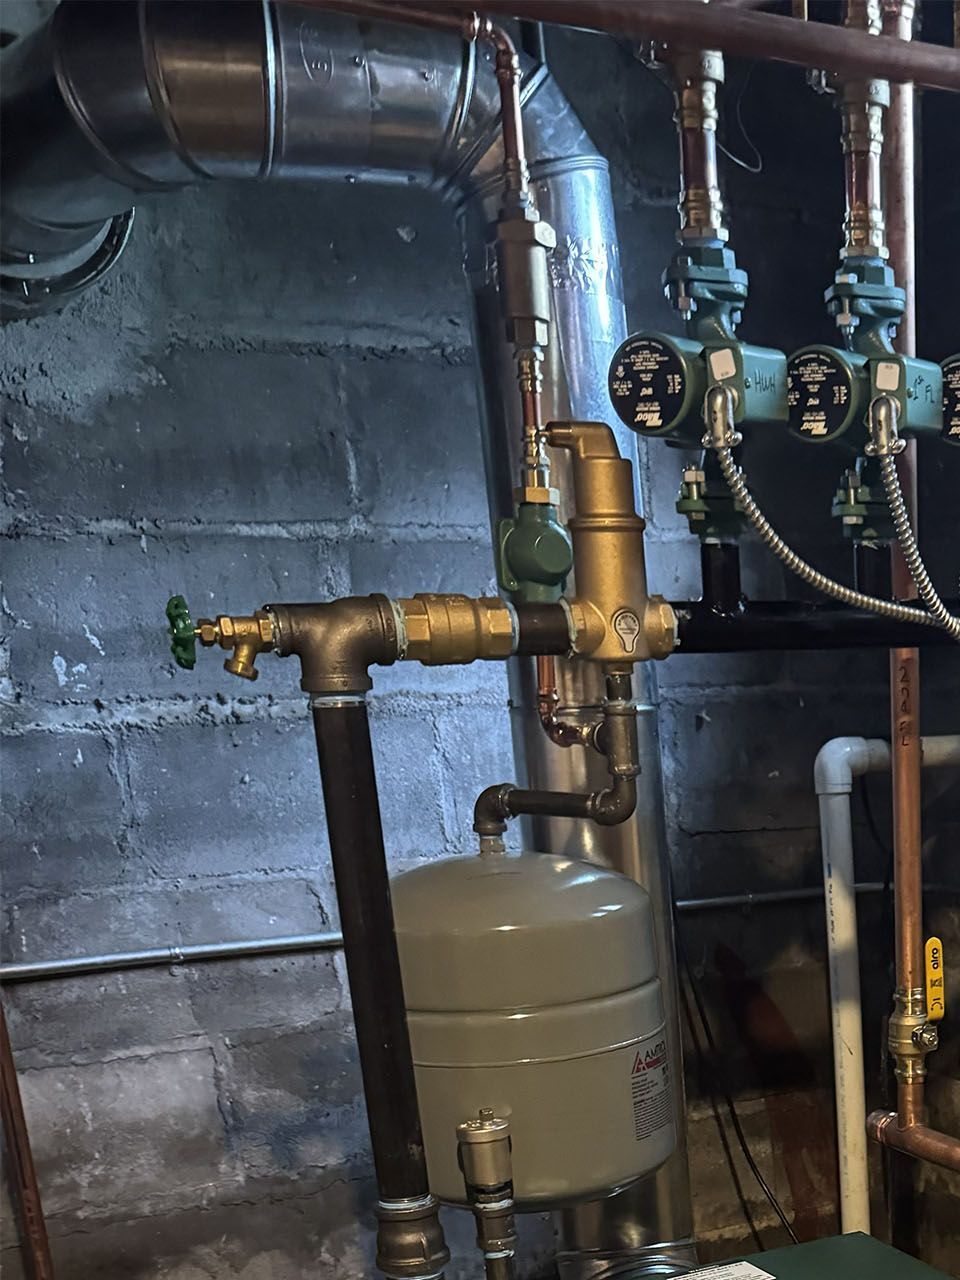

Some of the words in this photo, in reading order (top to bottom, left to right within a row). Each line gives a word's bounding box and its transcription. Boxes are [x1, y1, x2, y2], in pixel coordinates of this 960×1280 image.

[925, 384, 935, 403] FL
[634, 412, 663, 427] Taco
[800, 421, 828, 435] Taco
